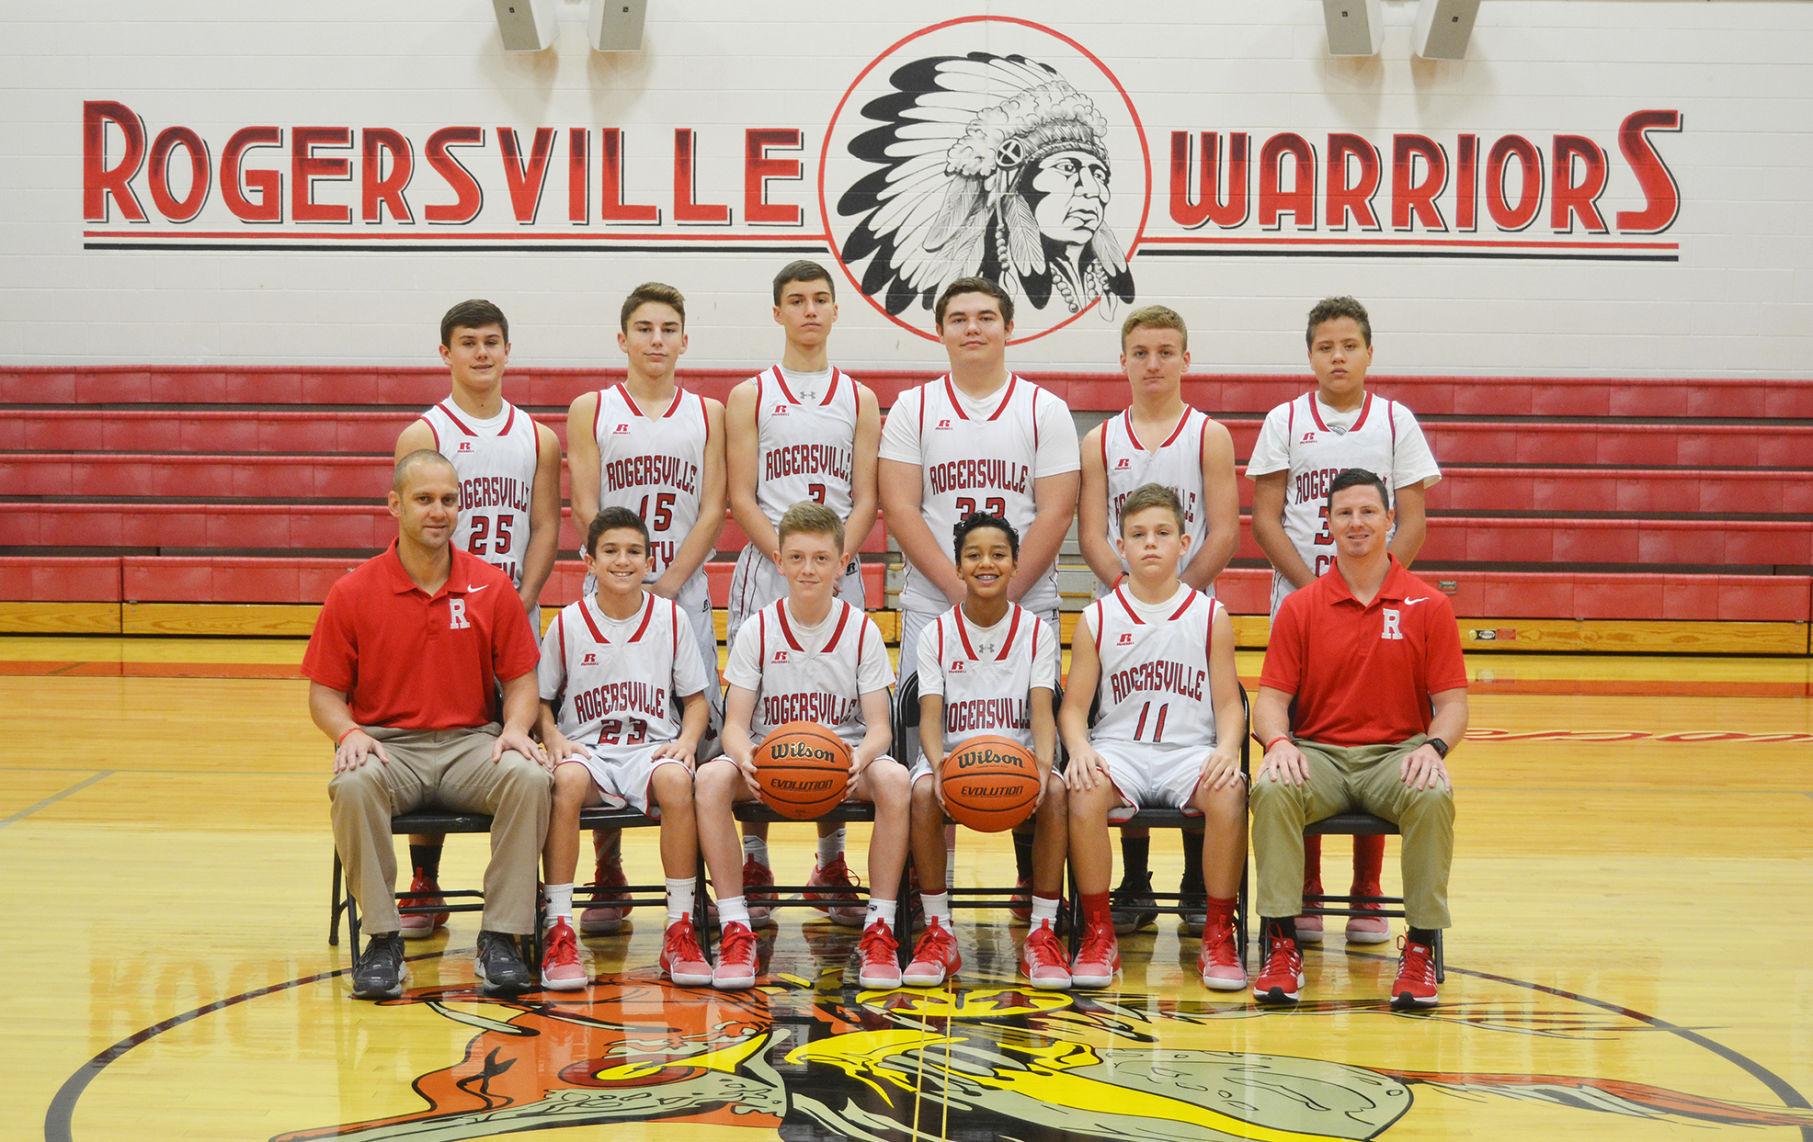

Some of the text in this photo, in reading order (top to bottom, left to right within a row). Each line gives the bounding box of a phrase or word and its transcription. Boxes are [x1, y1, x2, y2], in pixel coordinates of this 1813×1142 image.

[83, 100, 1683, 234] ROGERSVILLE WARRIORS
[606, 454, 698, 495] ROGERSVILLE
[929, 459, 1028, 495] ROGERSVILLE
[457, 476, 530, 513] OGERSVILL
[467, 514, 514, 556] 25
[649, 541, 675, 574] TY
[449, 598, 471, 630] R
[1381, 607, 1403, 640] R
[1110, 660, 1206, 705] ROGERSVILLE
[574, 681, 665, 725] ROGERSVILLE
[944, 698, 1031, 734] OGERSVILL
[597, 716, 648, 745] 23
[1133, 701, 1169, 742] 11
[771, 742, 835, 763] Wilson
[958, 749, 1024, 769] Wilson
[771, 778, 833, 792] EVOLUTION
[961, 785, 1024, 797] EVOLUTION
